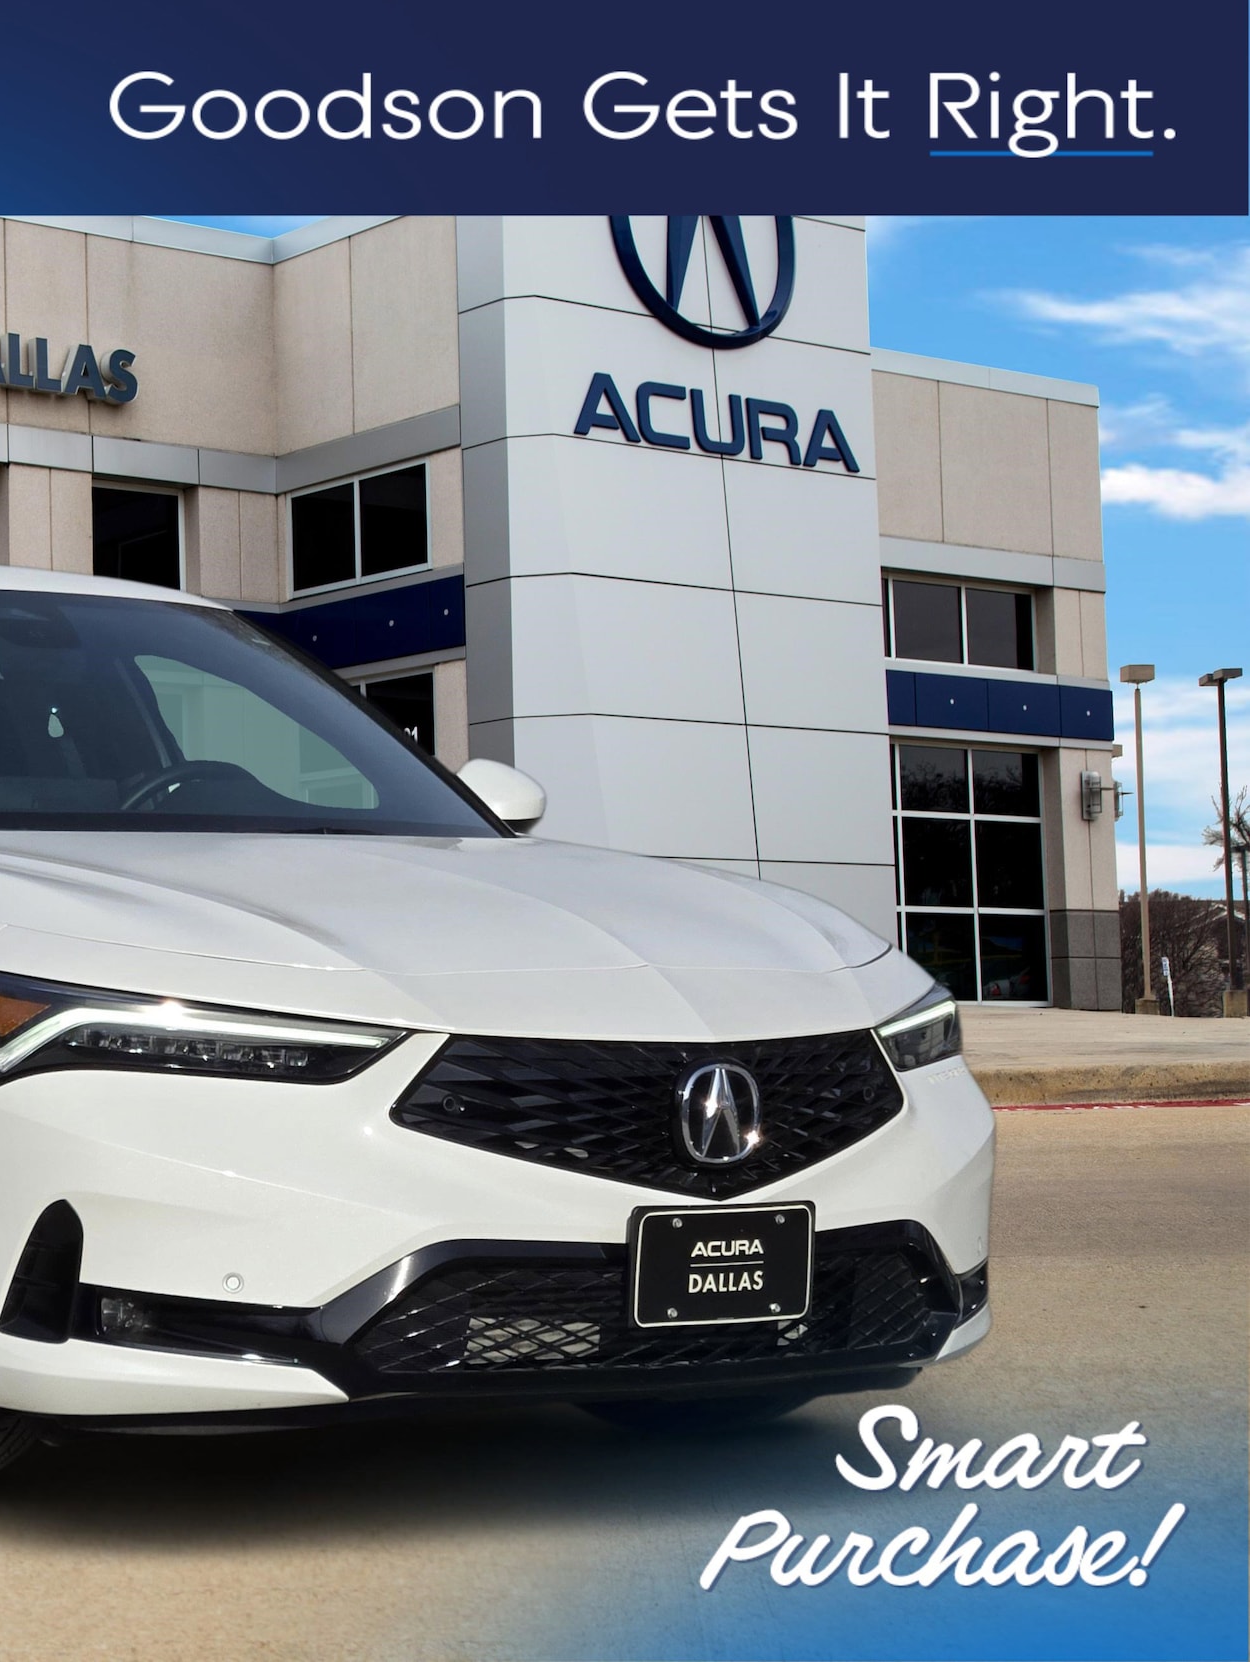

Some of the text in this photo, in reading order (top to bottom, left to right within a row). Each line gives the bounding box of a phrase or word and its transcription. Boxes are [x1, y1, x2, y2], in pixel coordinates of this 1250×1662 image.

[574, 371, 860, 473] ACURA
[690, 1238, 764, 1258] ACURA
[688, 1270, 764, 1294] DALLAS
